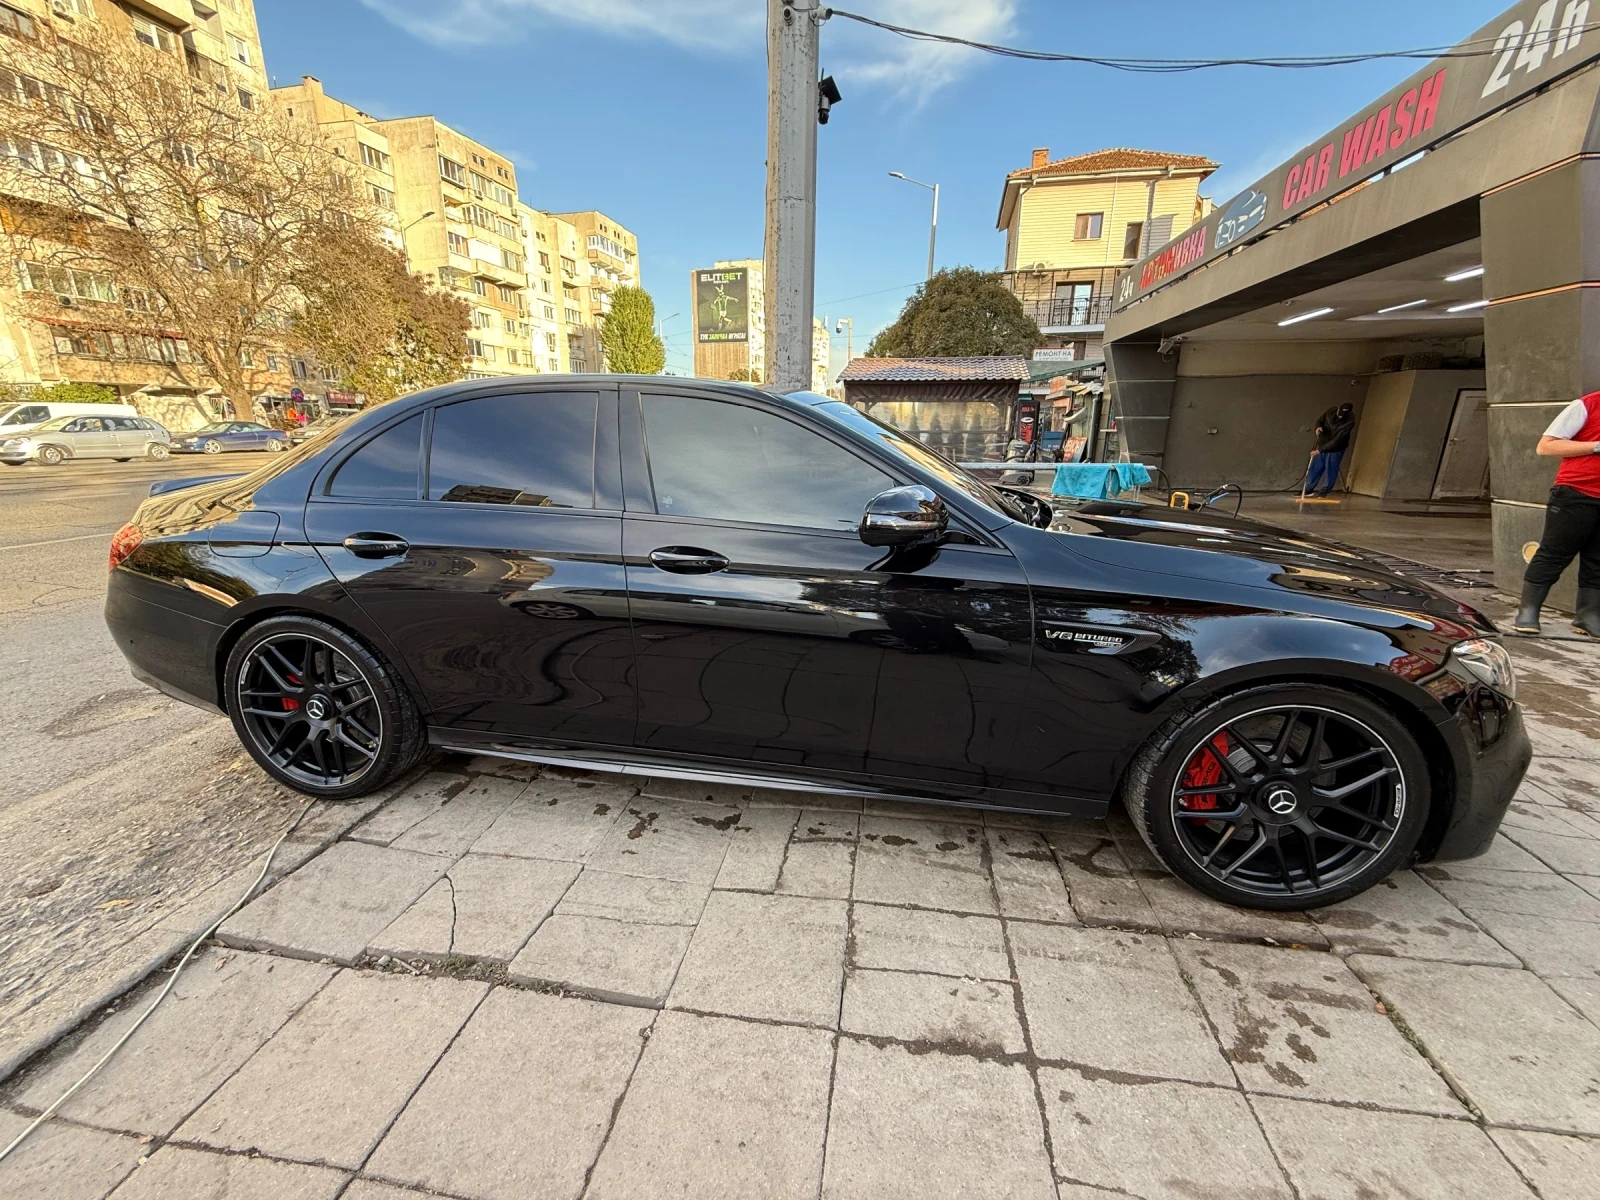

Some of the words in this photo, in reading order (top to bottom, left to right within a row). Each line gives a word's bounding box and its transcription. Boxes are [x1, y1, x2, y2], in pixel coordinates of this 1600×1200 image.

[1481, 0, 1590, 99] 24h
[1282, 143, 1334, 210] CAR
[1338, 67, 1447, 179] WASH
[700, 272, 743, 282] ELITBET
[1045, 629, 1074, 640] V8
[1074, 633, 1124, 643] BITURBO
